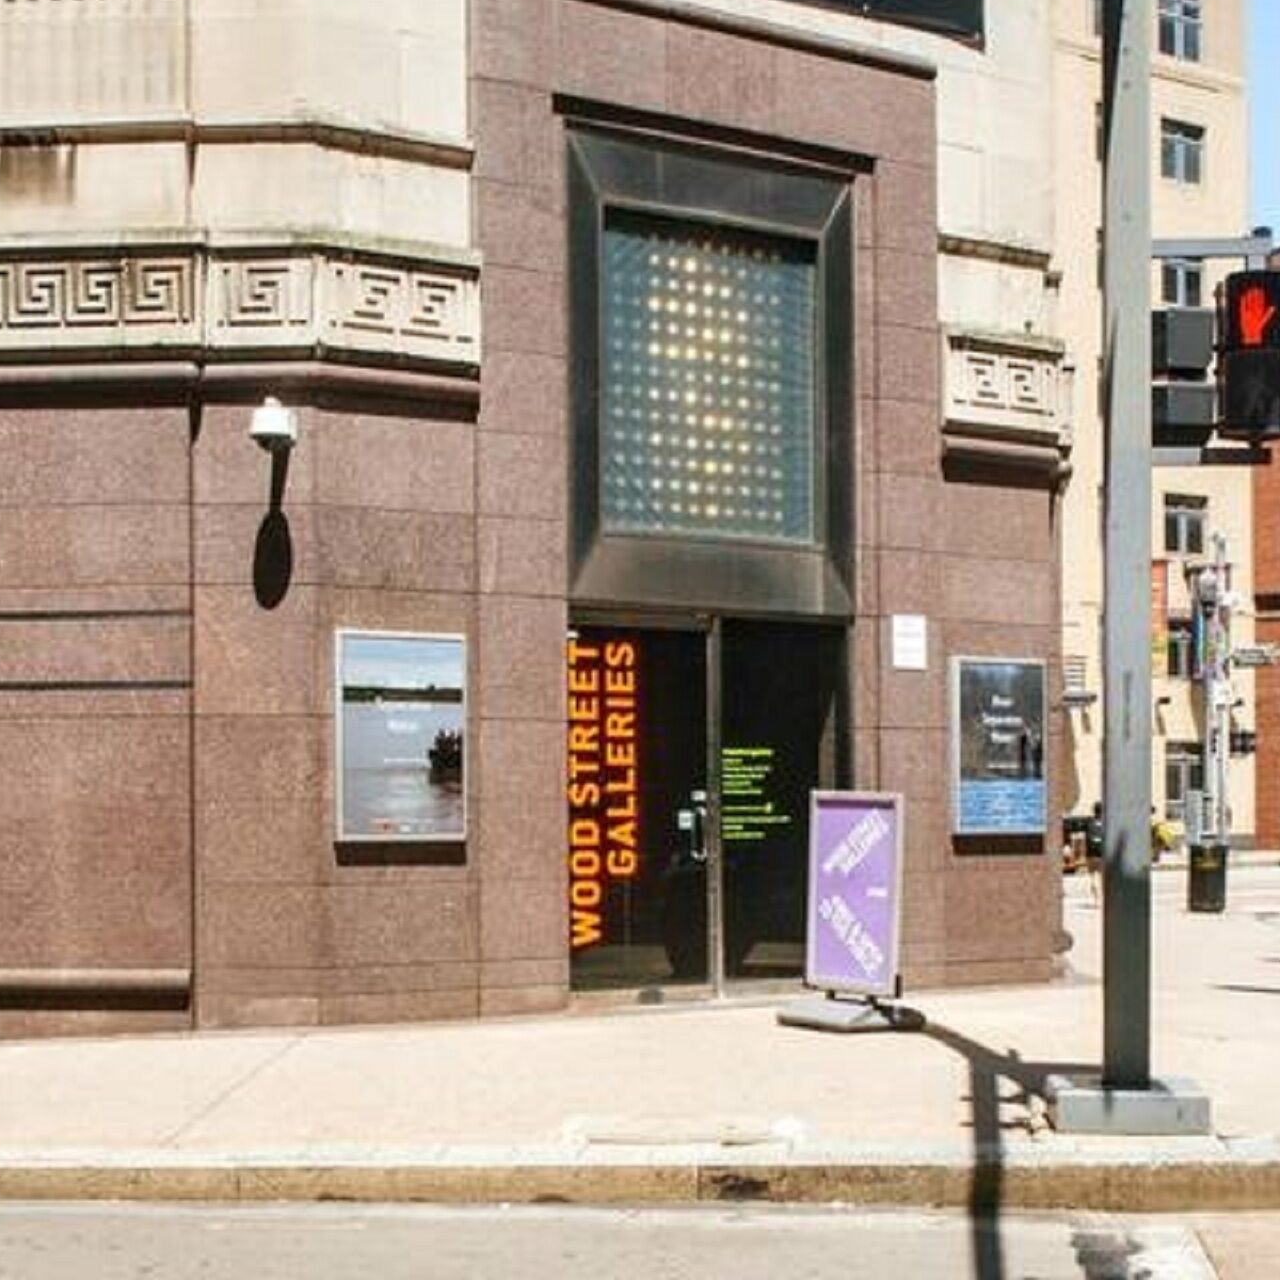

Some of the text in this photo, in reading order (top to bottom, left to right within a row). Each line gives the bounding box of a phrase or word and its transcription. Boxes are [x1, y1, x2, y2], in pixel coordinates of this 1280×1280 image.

[568, 639, 601, 947] WOOD STREET
[605, 641, 636, 876] GALLERIES
